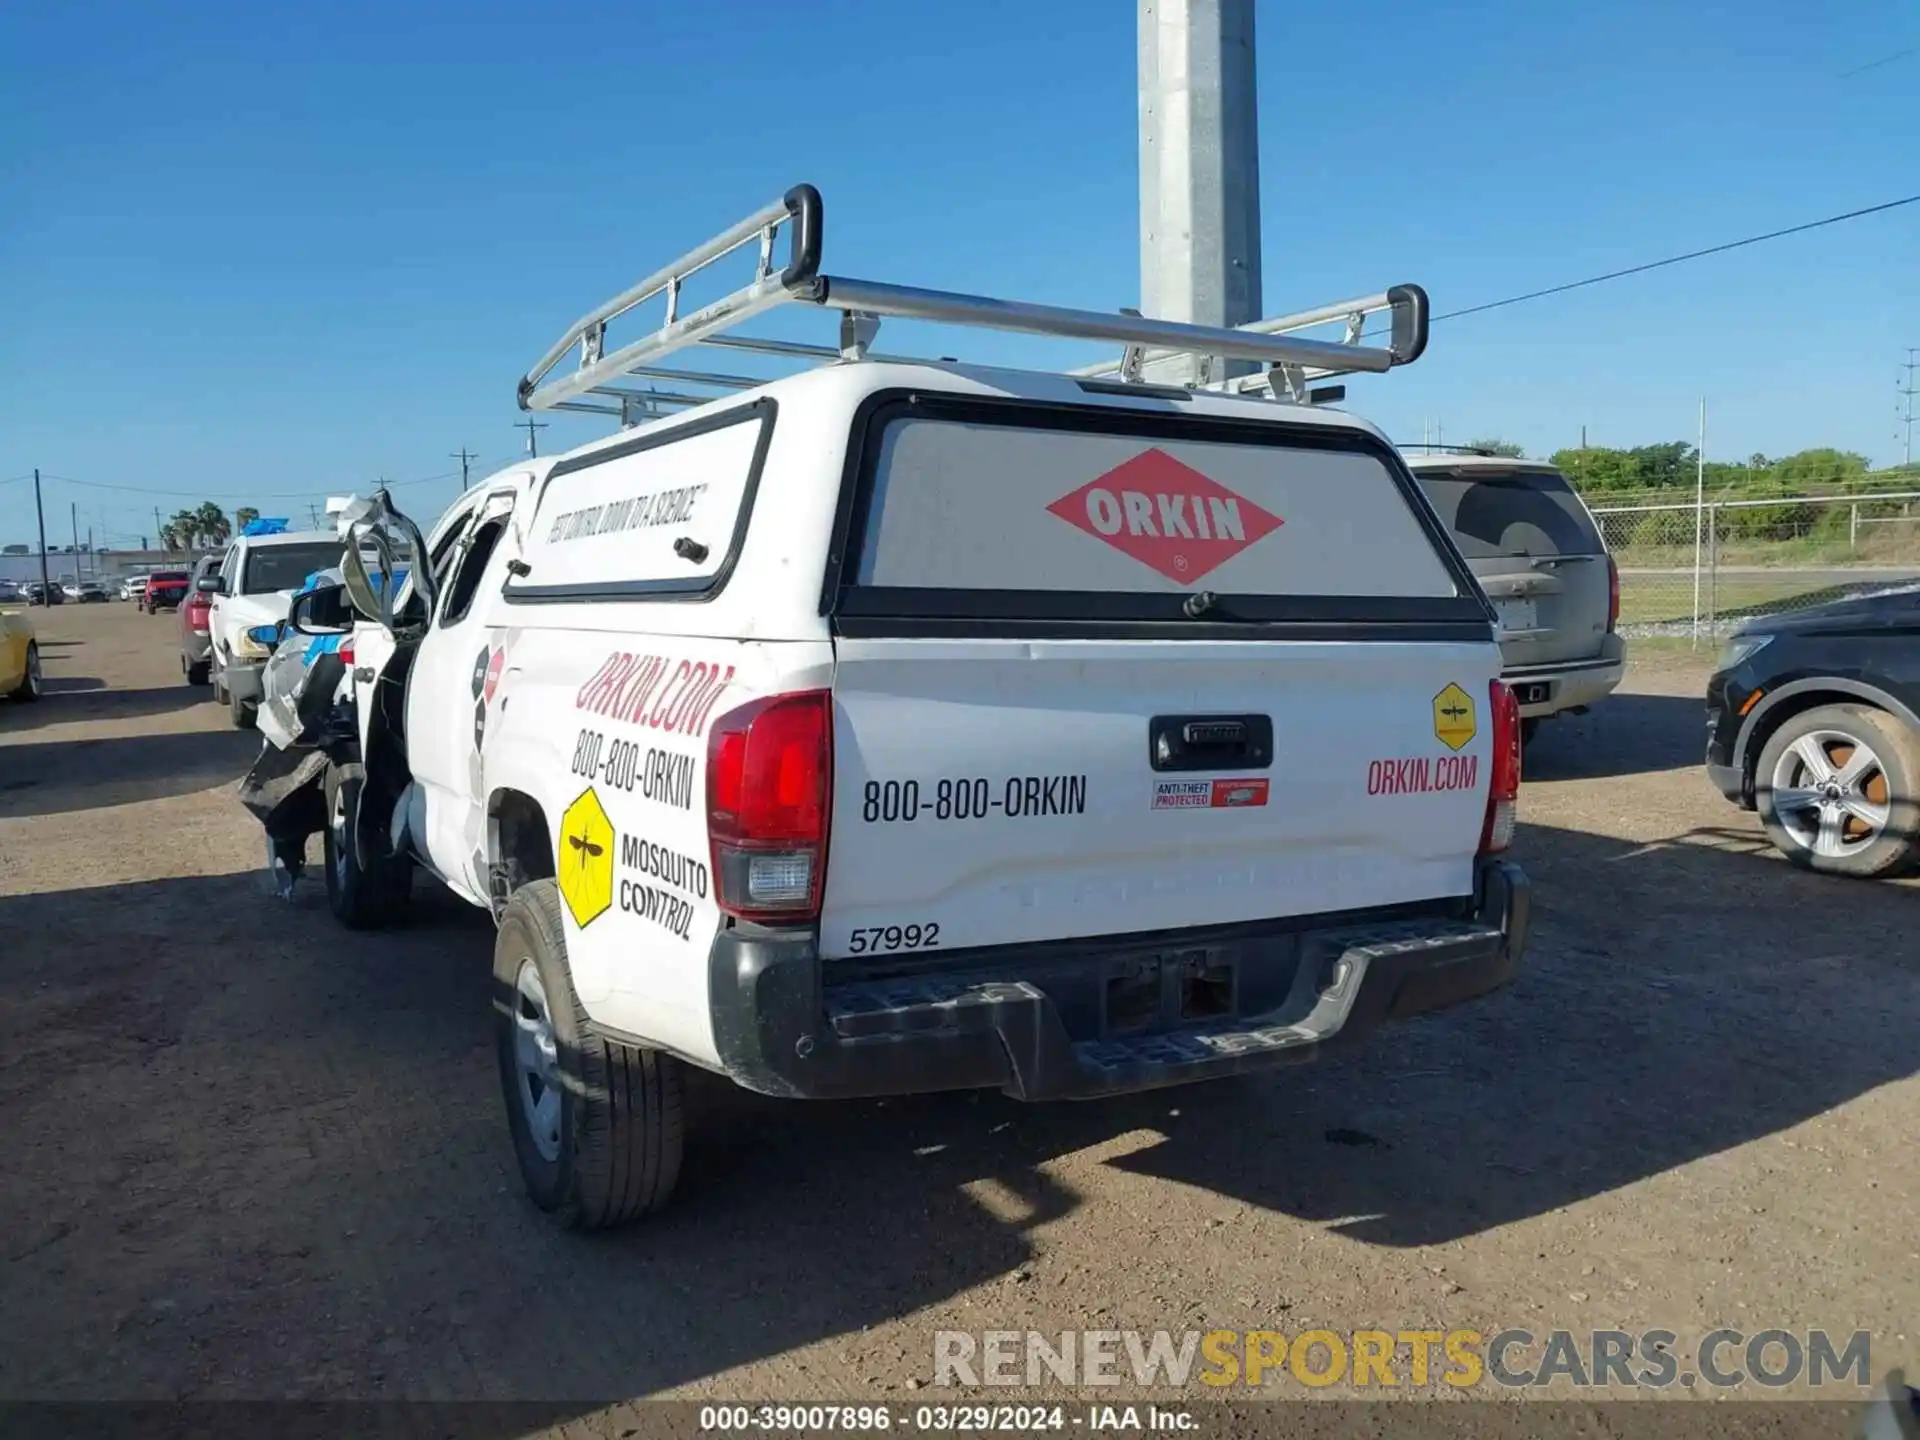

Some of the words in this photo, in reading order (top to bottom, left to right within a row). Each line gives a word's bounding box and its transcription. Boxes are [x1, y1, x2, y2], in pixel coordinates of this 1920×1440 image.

[1086, 487, 1246, 541] ORKIN
[576, 651, 735, 737] ORKIN.COM
[572, 728, 695, 810] 800-800-ORKIN
[1158, 783, 1209, 794] ANTI-THEFT
[1368, 755, 1477, 795] ORKIN.COM
[863, 775, 1086, 822] 800-800-ORKIN
[1155, 795, 1208, 807] PROTECTED
[622, 833, 707, 899] MOSQUITO
[620, 879, 694, 941] CONTROL
[849, 922, 940, 954] 57992
